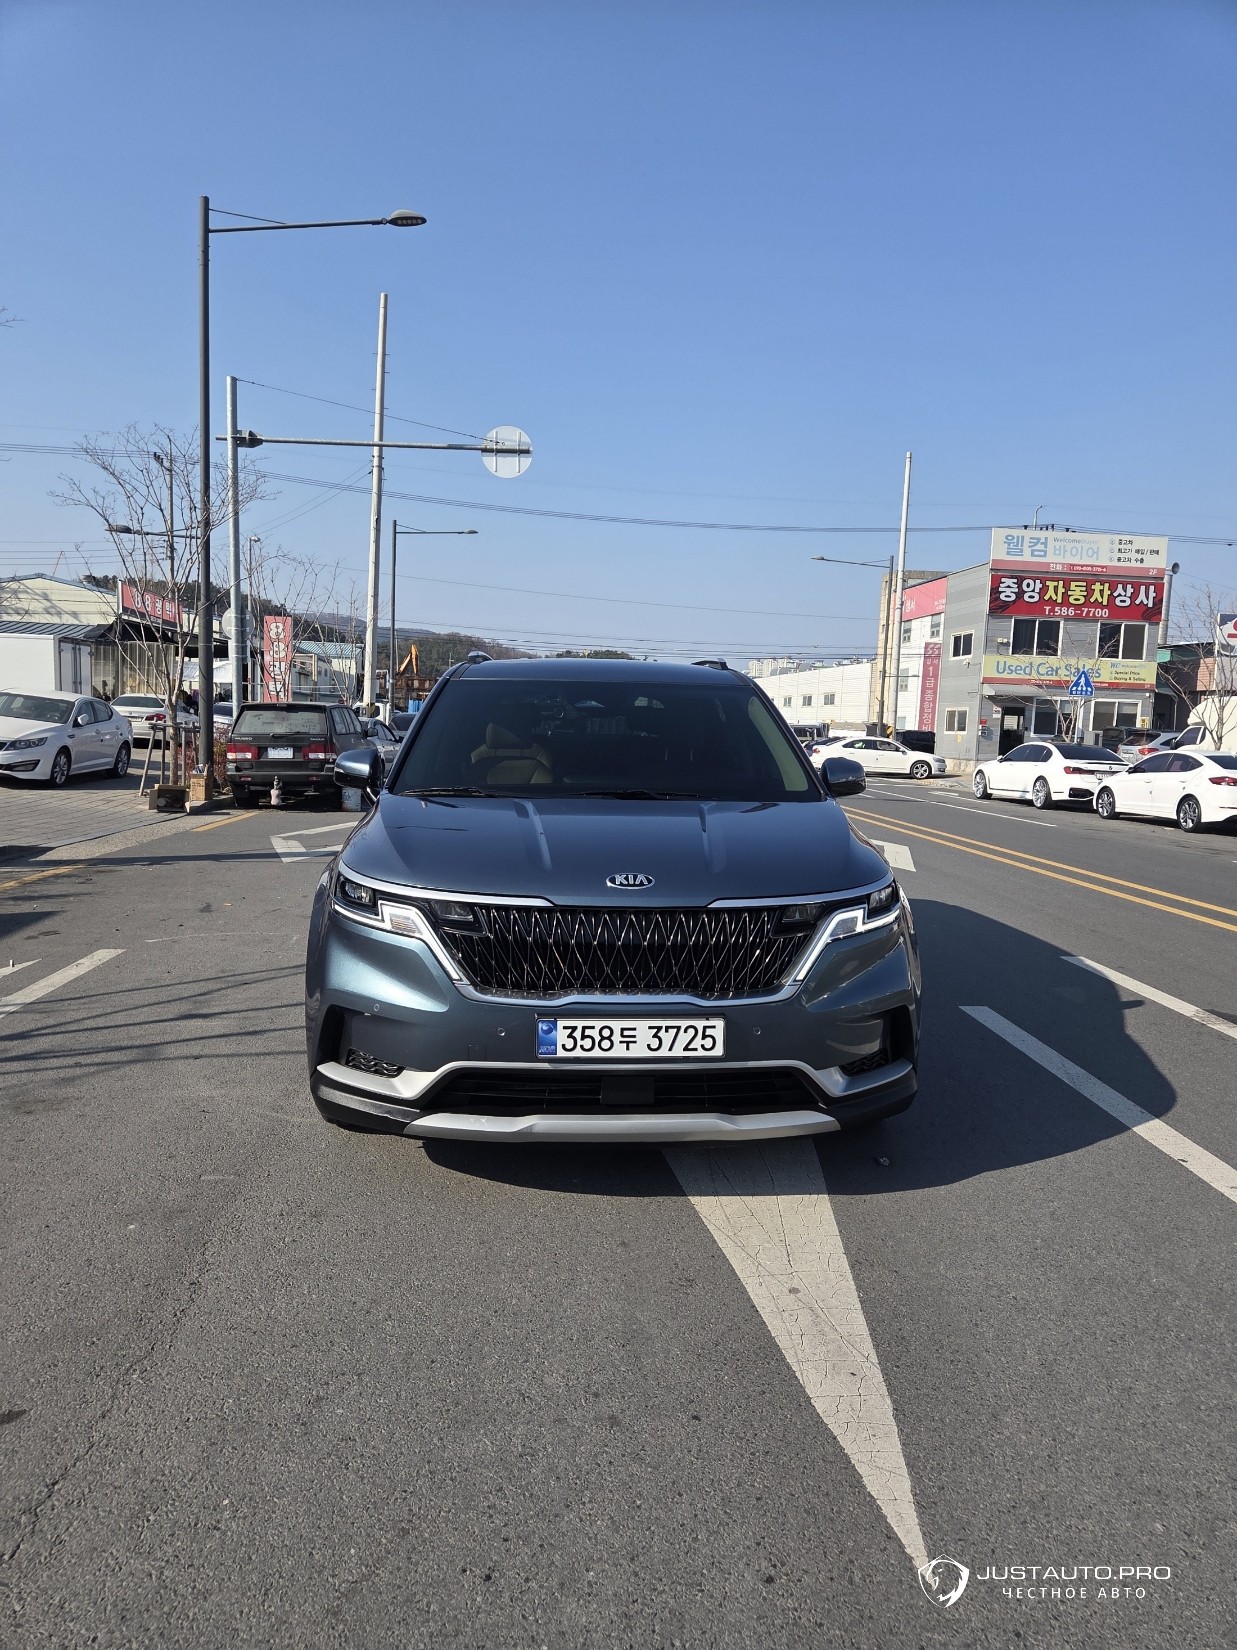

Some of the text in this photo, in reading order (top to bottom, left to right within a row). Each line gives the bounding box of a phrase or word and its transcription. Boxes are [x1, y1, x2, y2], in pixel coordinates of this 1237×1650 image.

[1003, 534, 1048, 557] 웰컴
[1053, 545, 1099, 561] 바이어
[998, 578, 1156, 608] 중앙자동차상사
[1044, 606, 1109, 618] T.586-7700
[996, 661, 1102, 679] Used Car Sales
[614, 874, 649, 885] KIA
[561, 1025, 718, 1052] 358두 3725
